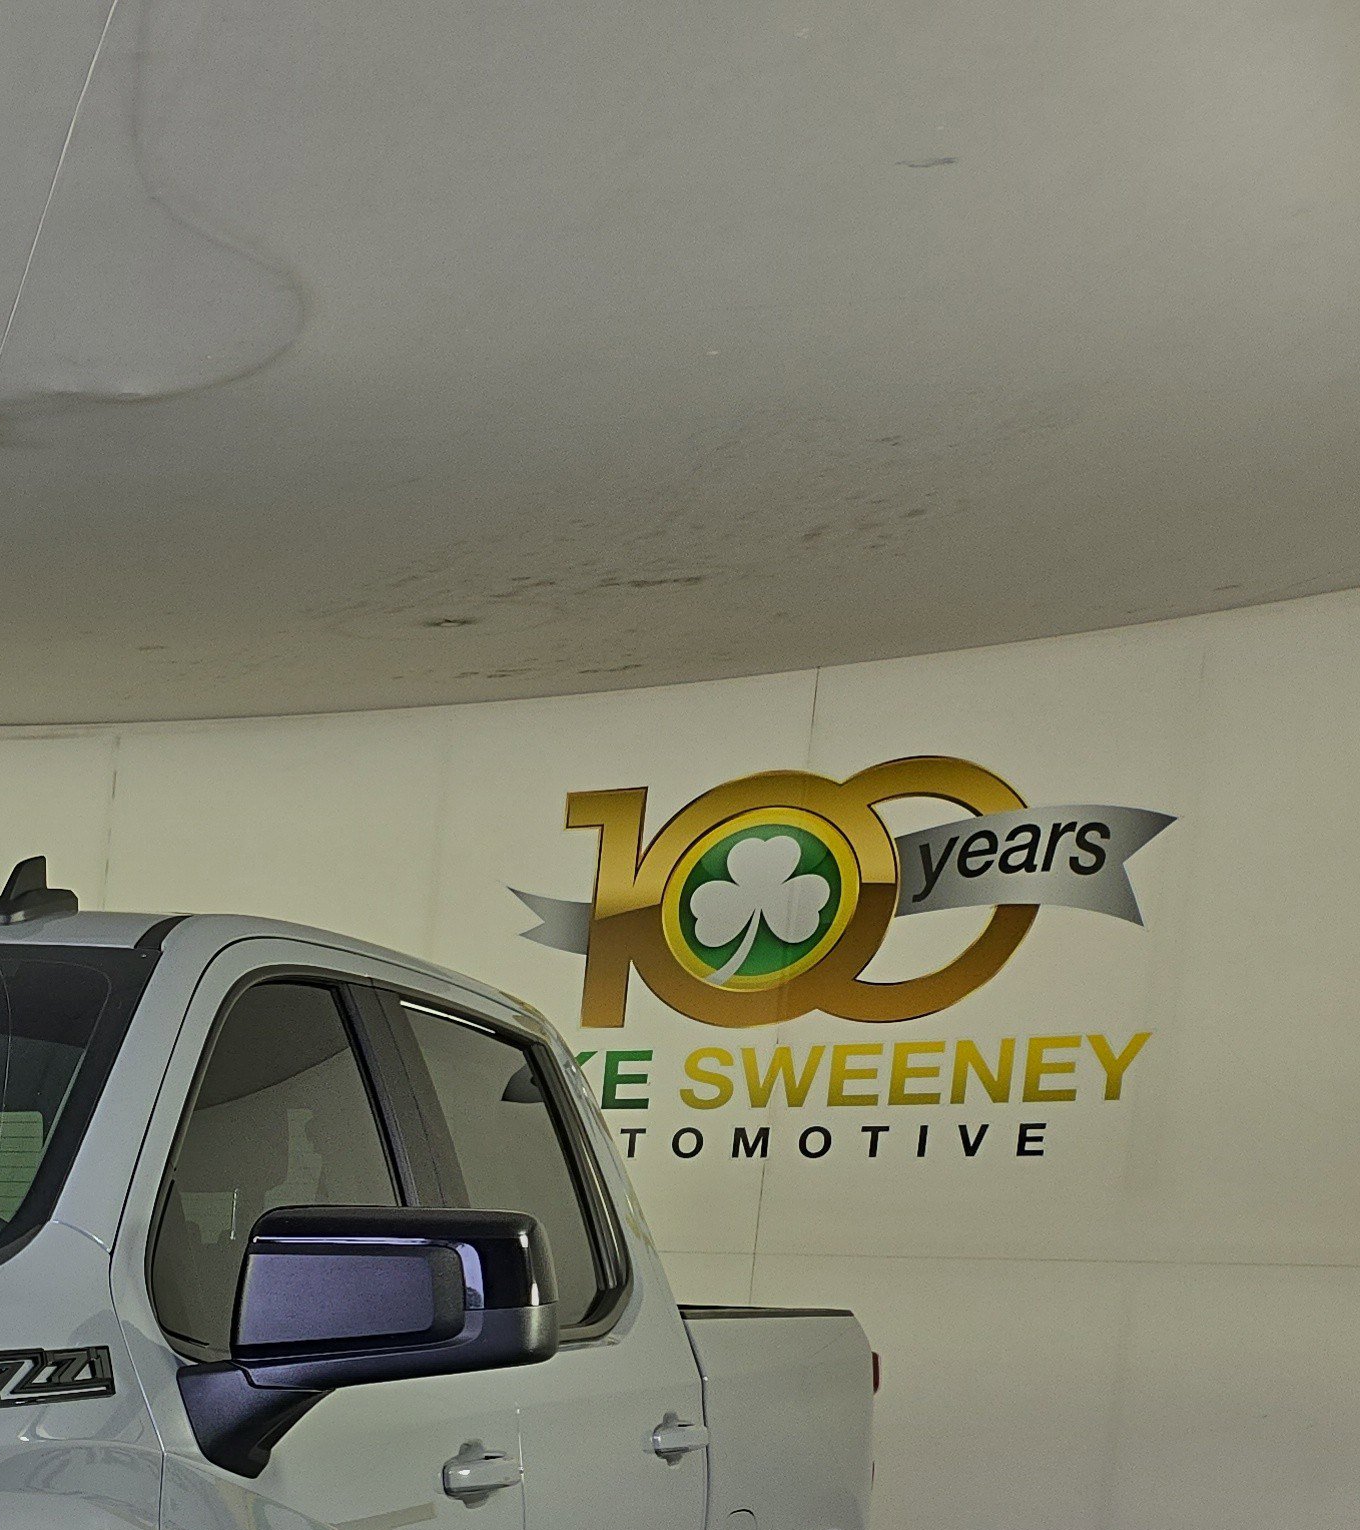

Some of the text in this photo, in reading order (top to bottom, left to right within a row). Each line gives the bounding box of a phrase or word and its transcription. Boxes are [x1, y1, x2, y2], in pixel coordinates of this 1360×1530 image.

[563, 755, 1111, 1029] 100 years
[678, 1031, 1154, 1109] SWEENEY
[619, 1122, 1048, 1158] TOMOTIVE
